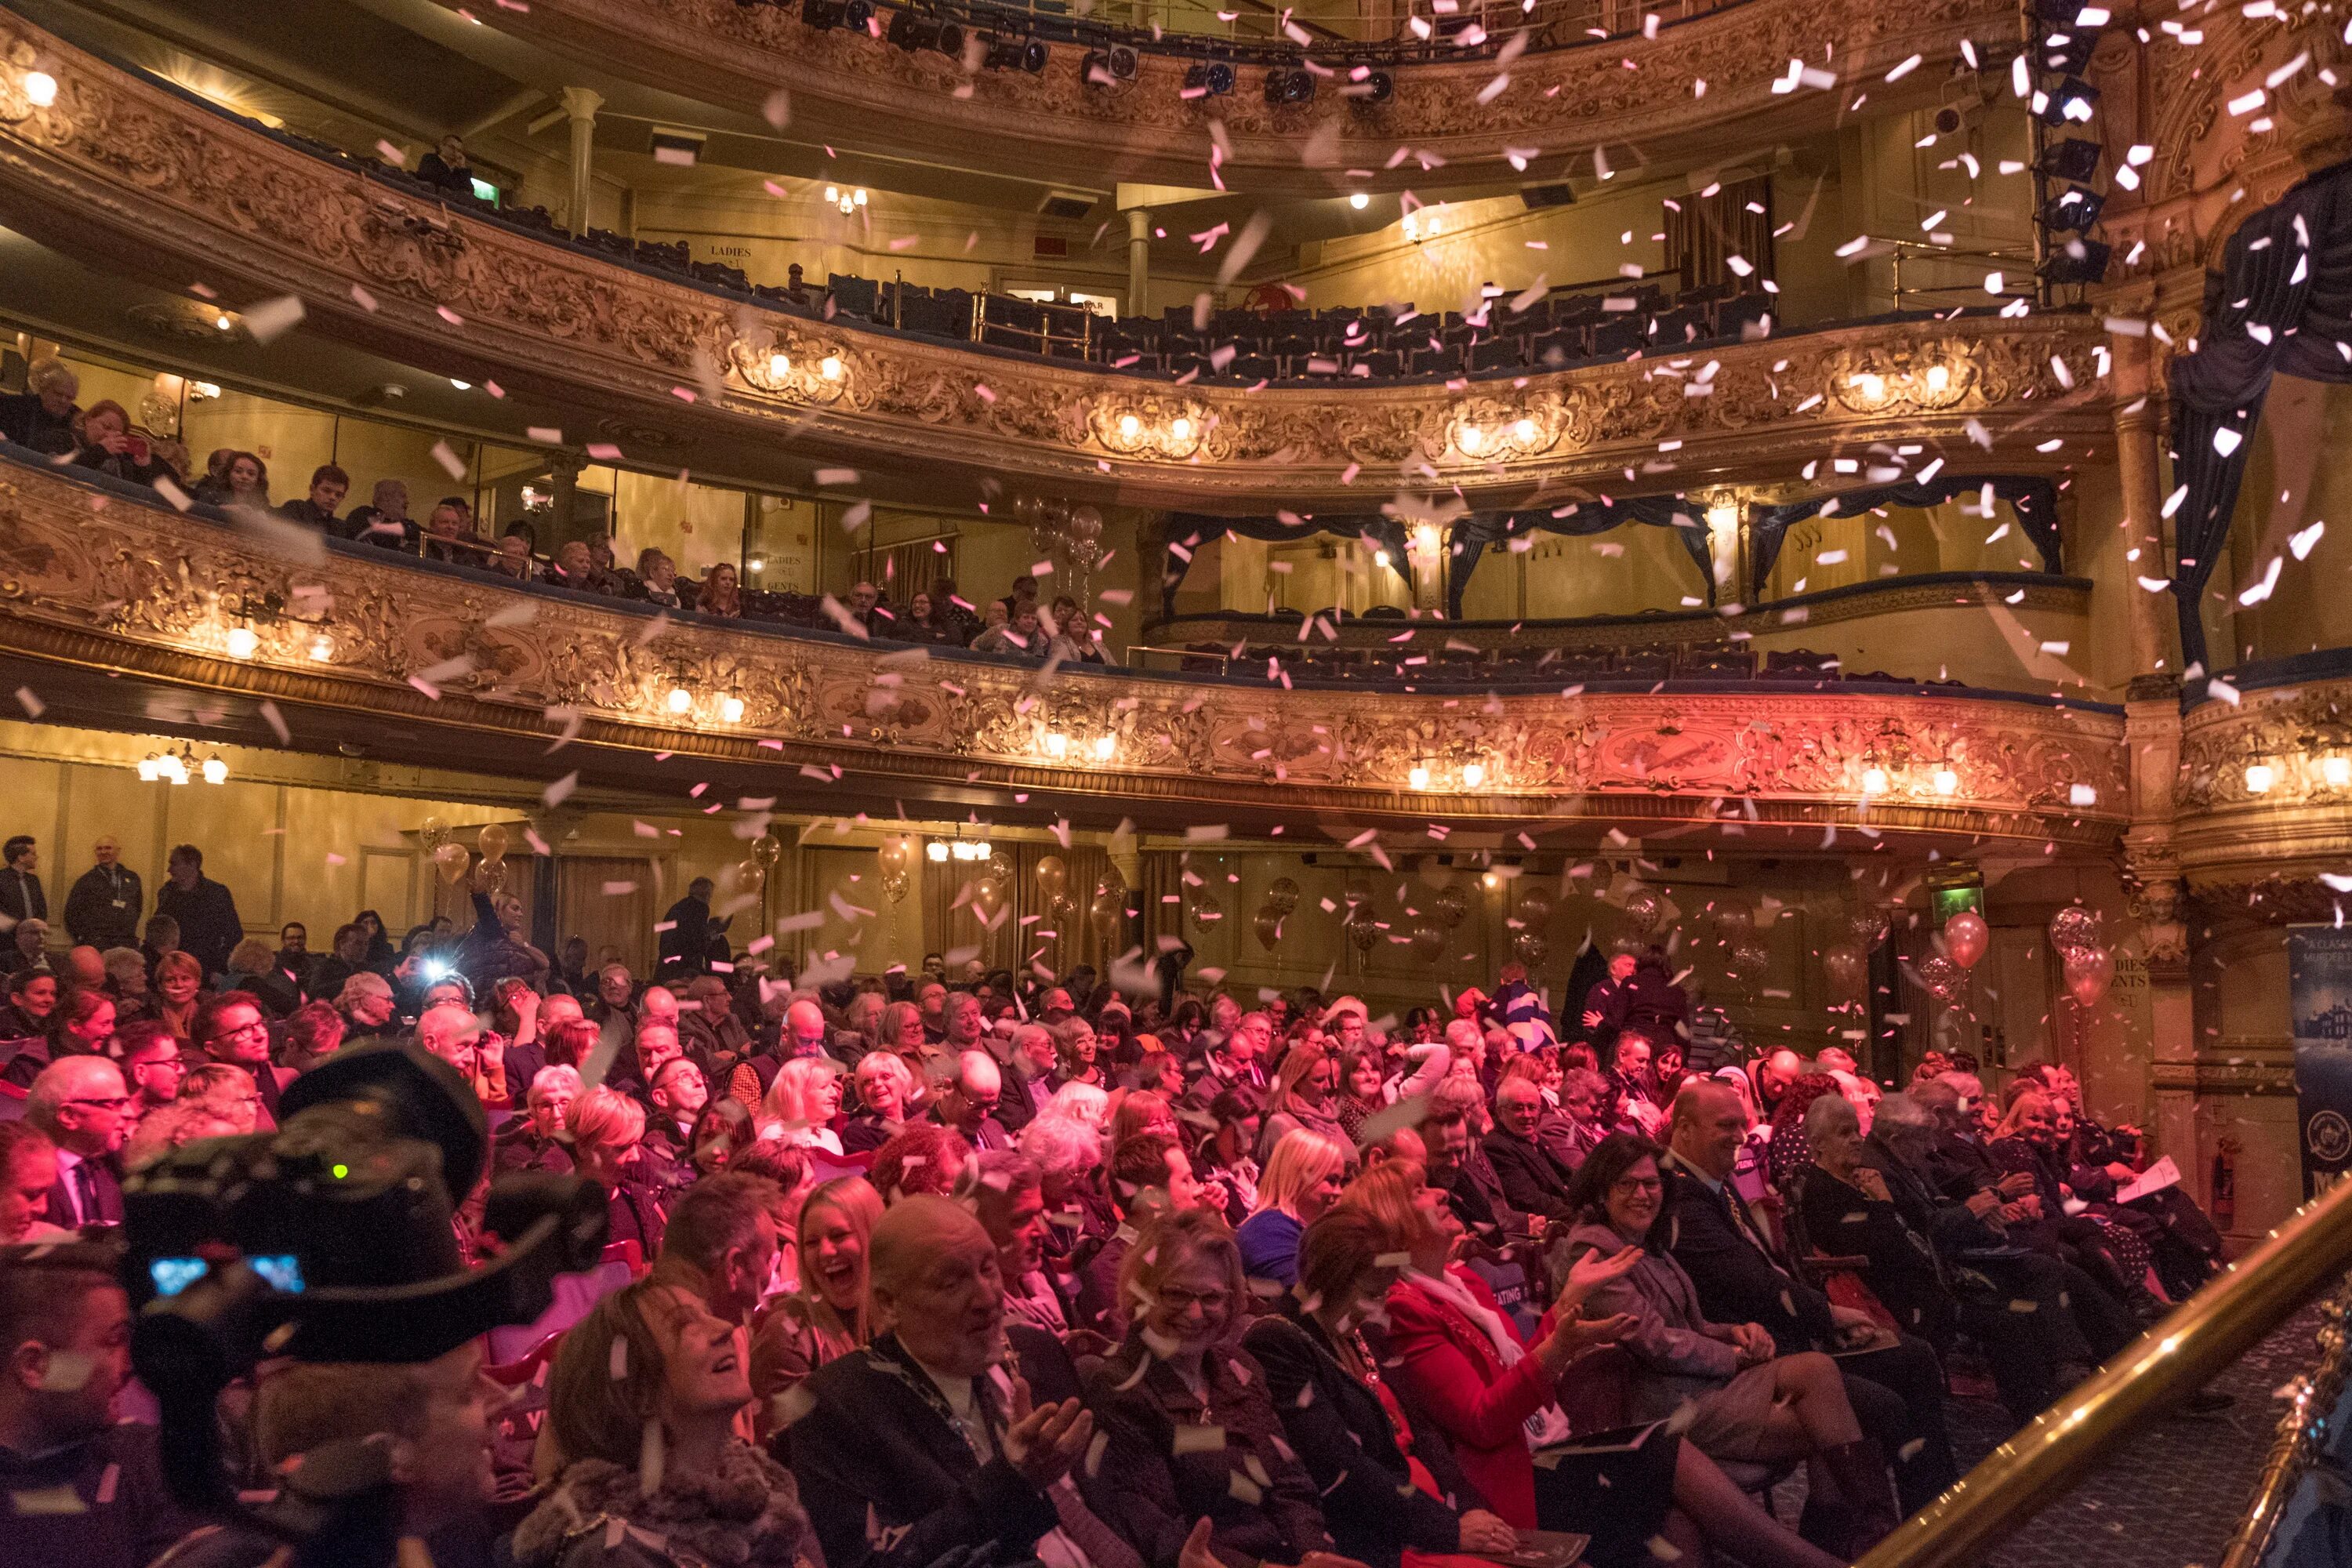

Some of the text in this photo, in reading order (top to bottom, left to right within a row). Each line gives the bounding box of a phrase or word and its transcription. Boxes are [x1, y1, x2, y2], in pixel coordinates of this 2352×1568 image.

[711, 245, 751, 257] LADIES
[767, 556, 801, 564] LADIES
[768, 582, 799, 590] GENTS
